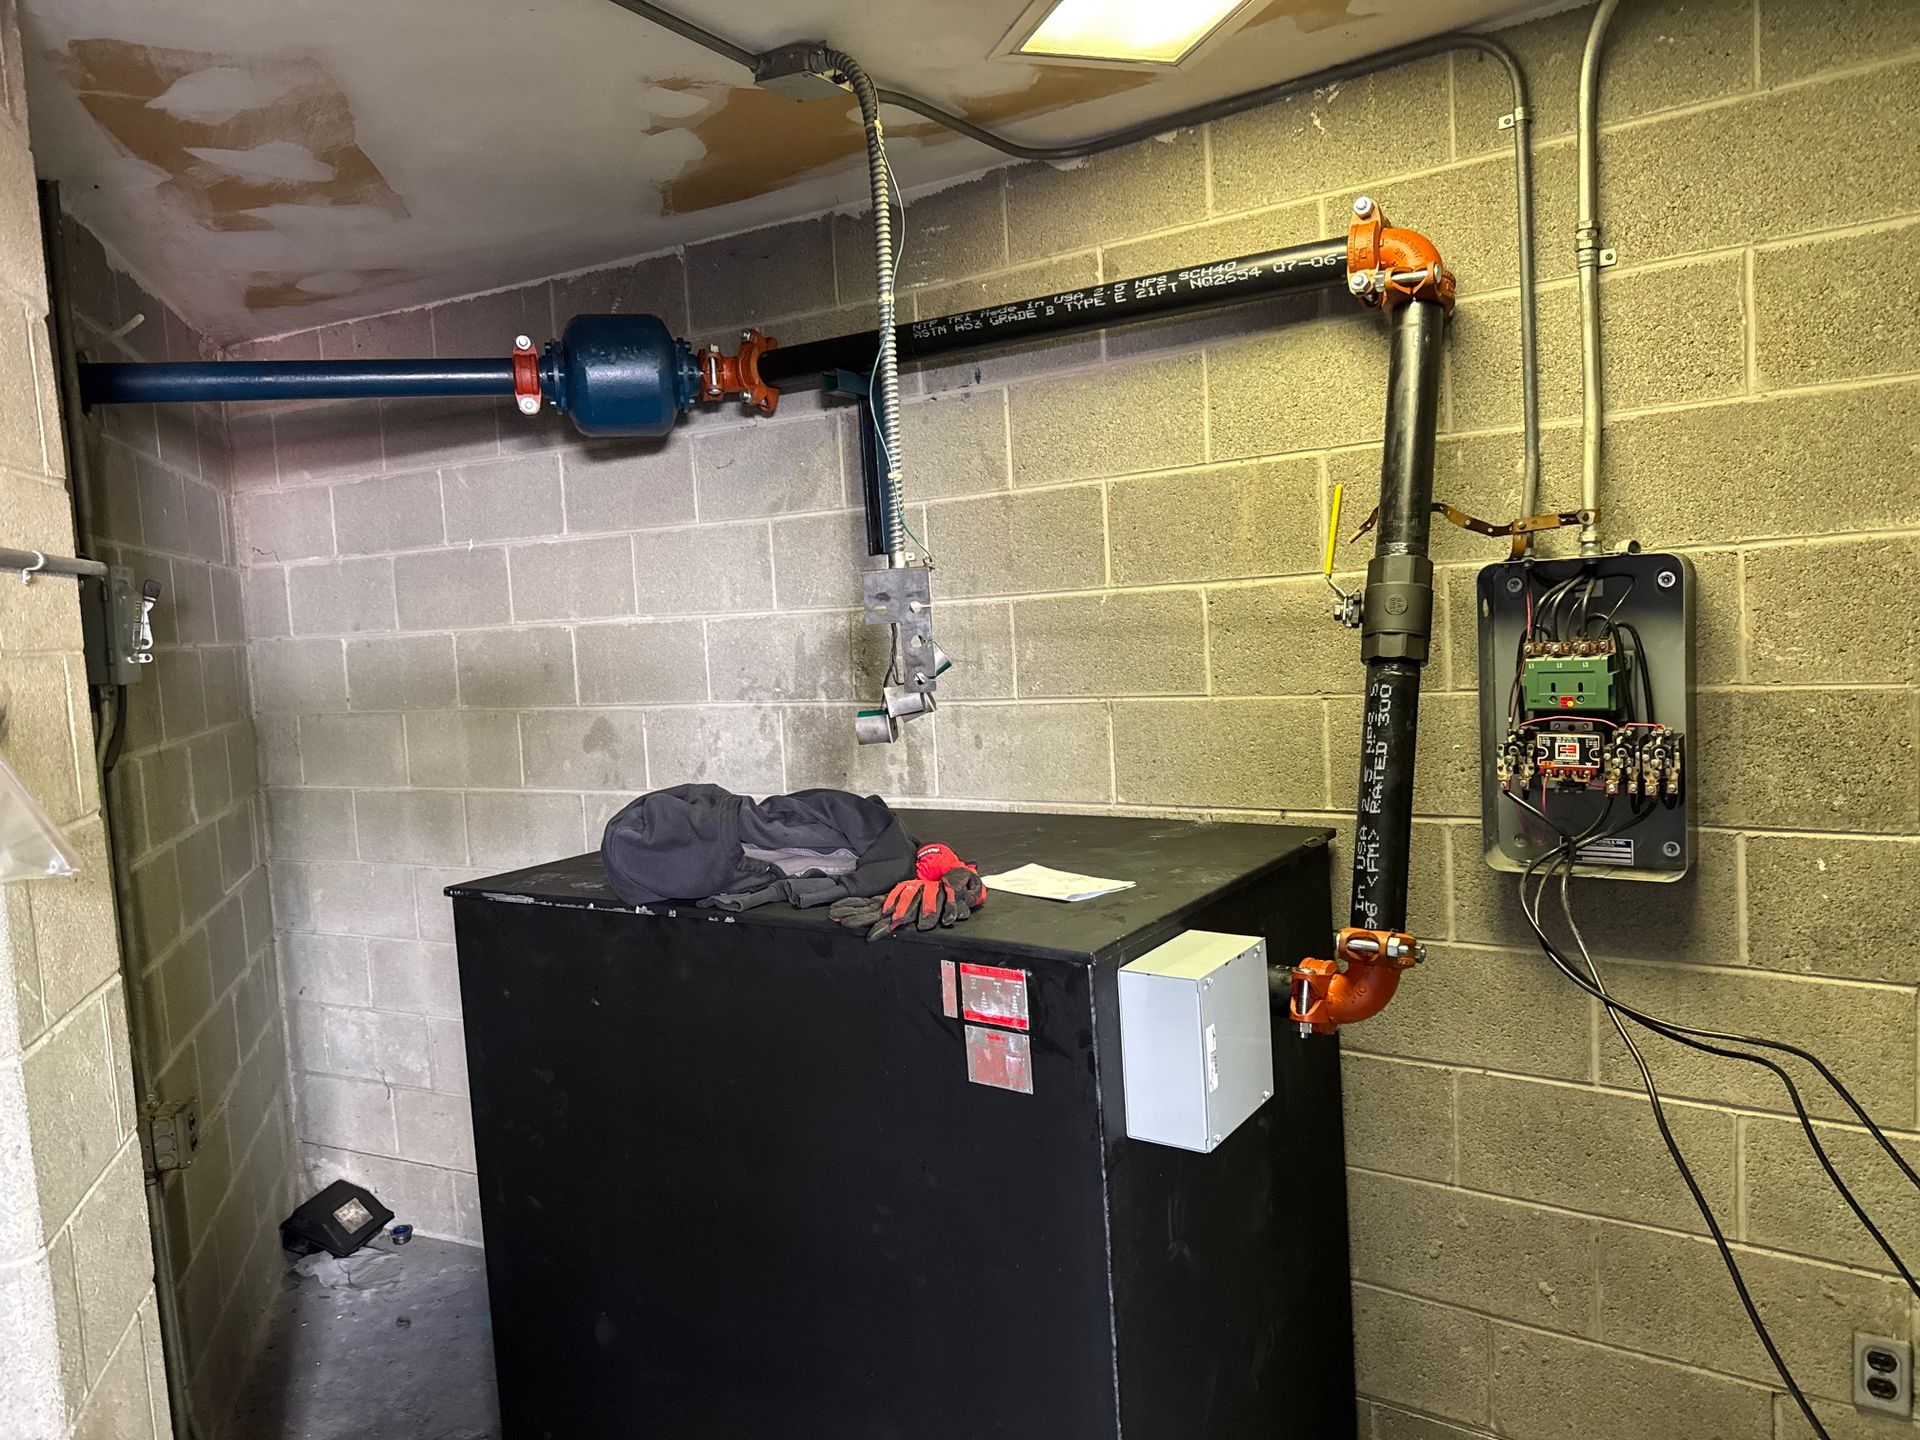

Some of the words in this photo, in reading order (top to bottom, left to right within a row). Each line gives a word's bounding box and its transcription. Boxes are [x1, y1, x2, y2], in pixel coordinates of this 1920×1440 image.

[1054, 291, 1084, 304] USA
[1093, 283, 1127, 297] 2.5
[1135, 275, 1167, 288] NPS
[1178, 261, 1236, 281] SCH40
[911, 325, 947, 339] ASTM
[954, 319, 983, 332] A53
[989, 308, 1037, 326] GRADE
[1045, 305, 1055, 316] B
[1064, 297, 1106, 312] TYPE
[1114, 292, 1127, 304] E
[1135, 282, 1178, 299] 21FT
[1377, 684, 1392, 727] 300
[1369, 741, 1389, 814] RATED
[1357, 824, 1368, 870] USA
